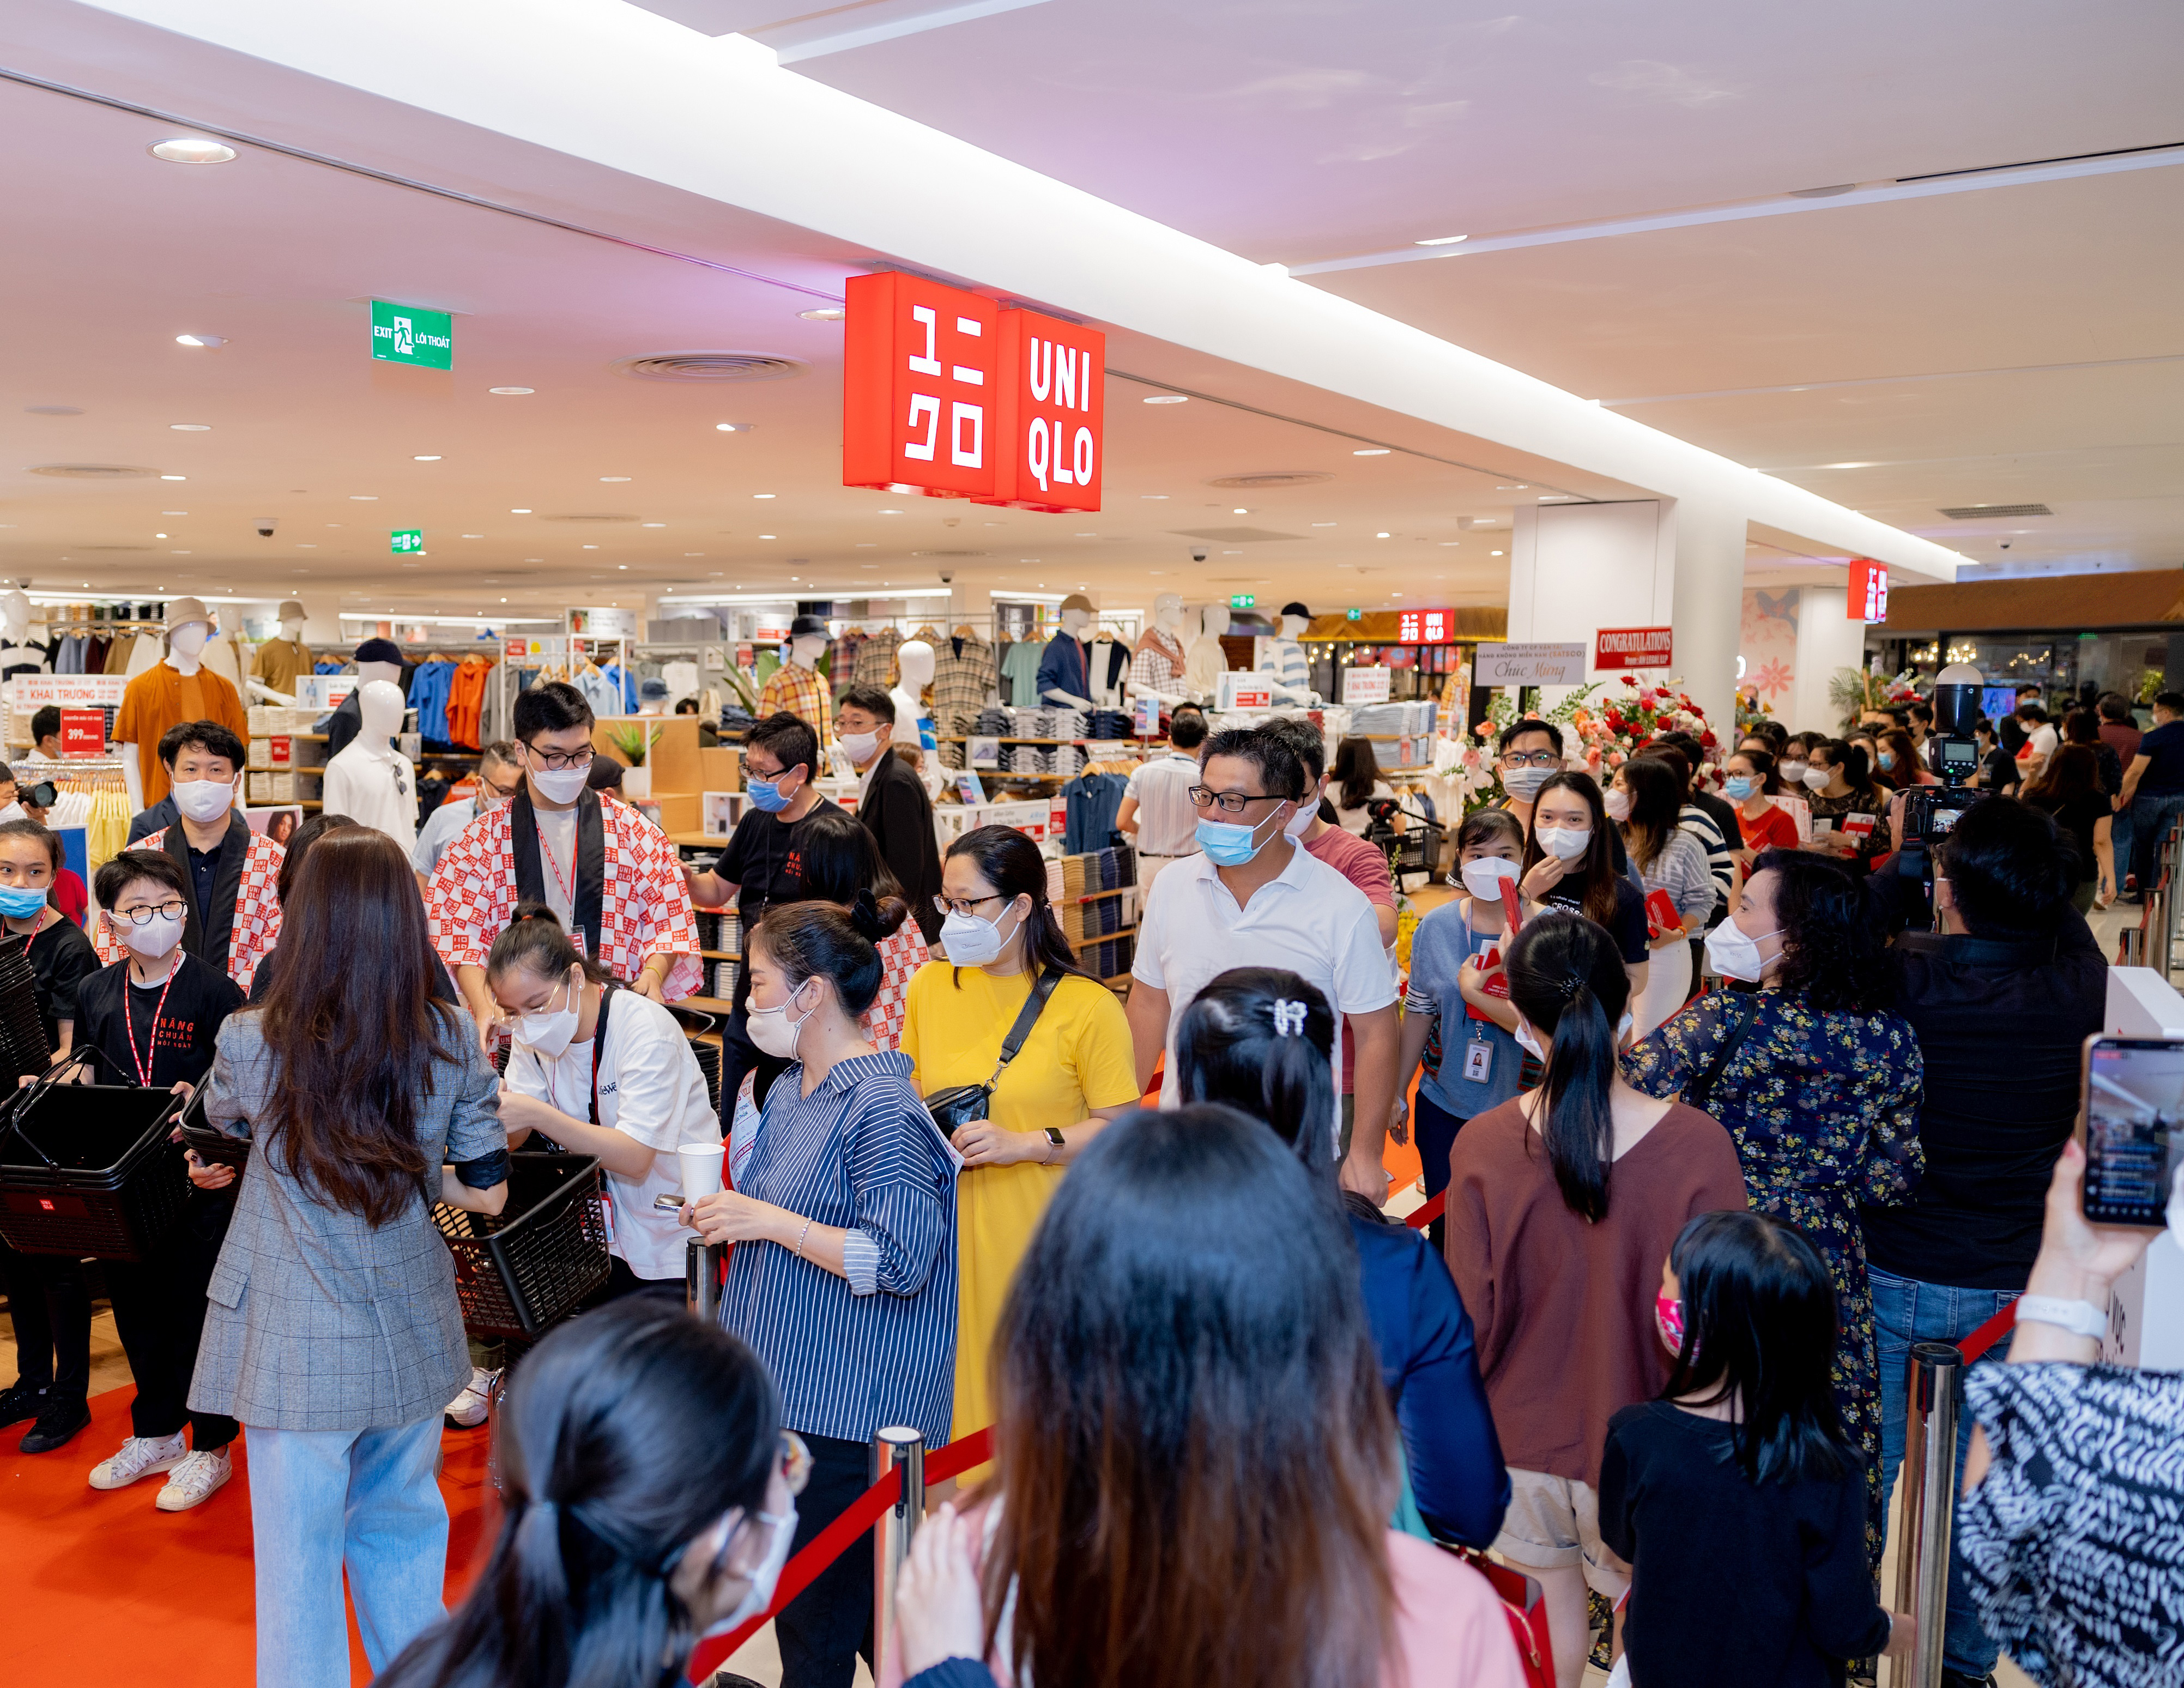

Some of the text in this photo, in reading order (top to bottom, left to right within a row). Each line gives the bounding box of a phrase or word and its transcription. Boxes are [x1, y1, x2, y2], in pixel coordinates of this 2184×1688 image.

[374, 325, 392, 338] EXIT
[427, 335, 450, 348] THOÁT
[909, 304, 984, 386] ユニ
[1030, 336, 1090, 412] UNI
[904, 392, 983, 469] クロ
[1028, 416, 1094, 492] QLO
[1425, 613, 1443, 626] UNI
[1425, 627, 1444, 642] QLO
[1600, 631, 1671, 653] CONGRATULATIONS
[1495, 660, 1566, 682] Chúc Mừng
[31, 690, 53, 699] KHAI
[619, 866, 631, 874] UNI
[160, 1018, 194, 1032] NÂNG
[874, 1024, 887, 1032] UNI
[876, 1030, 888, 1038] QLO
